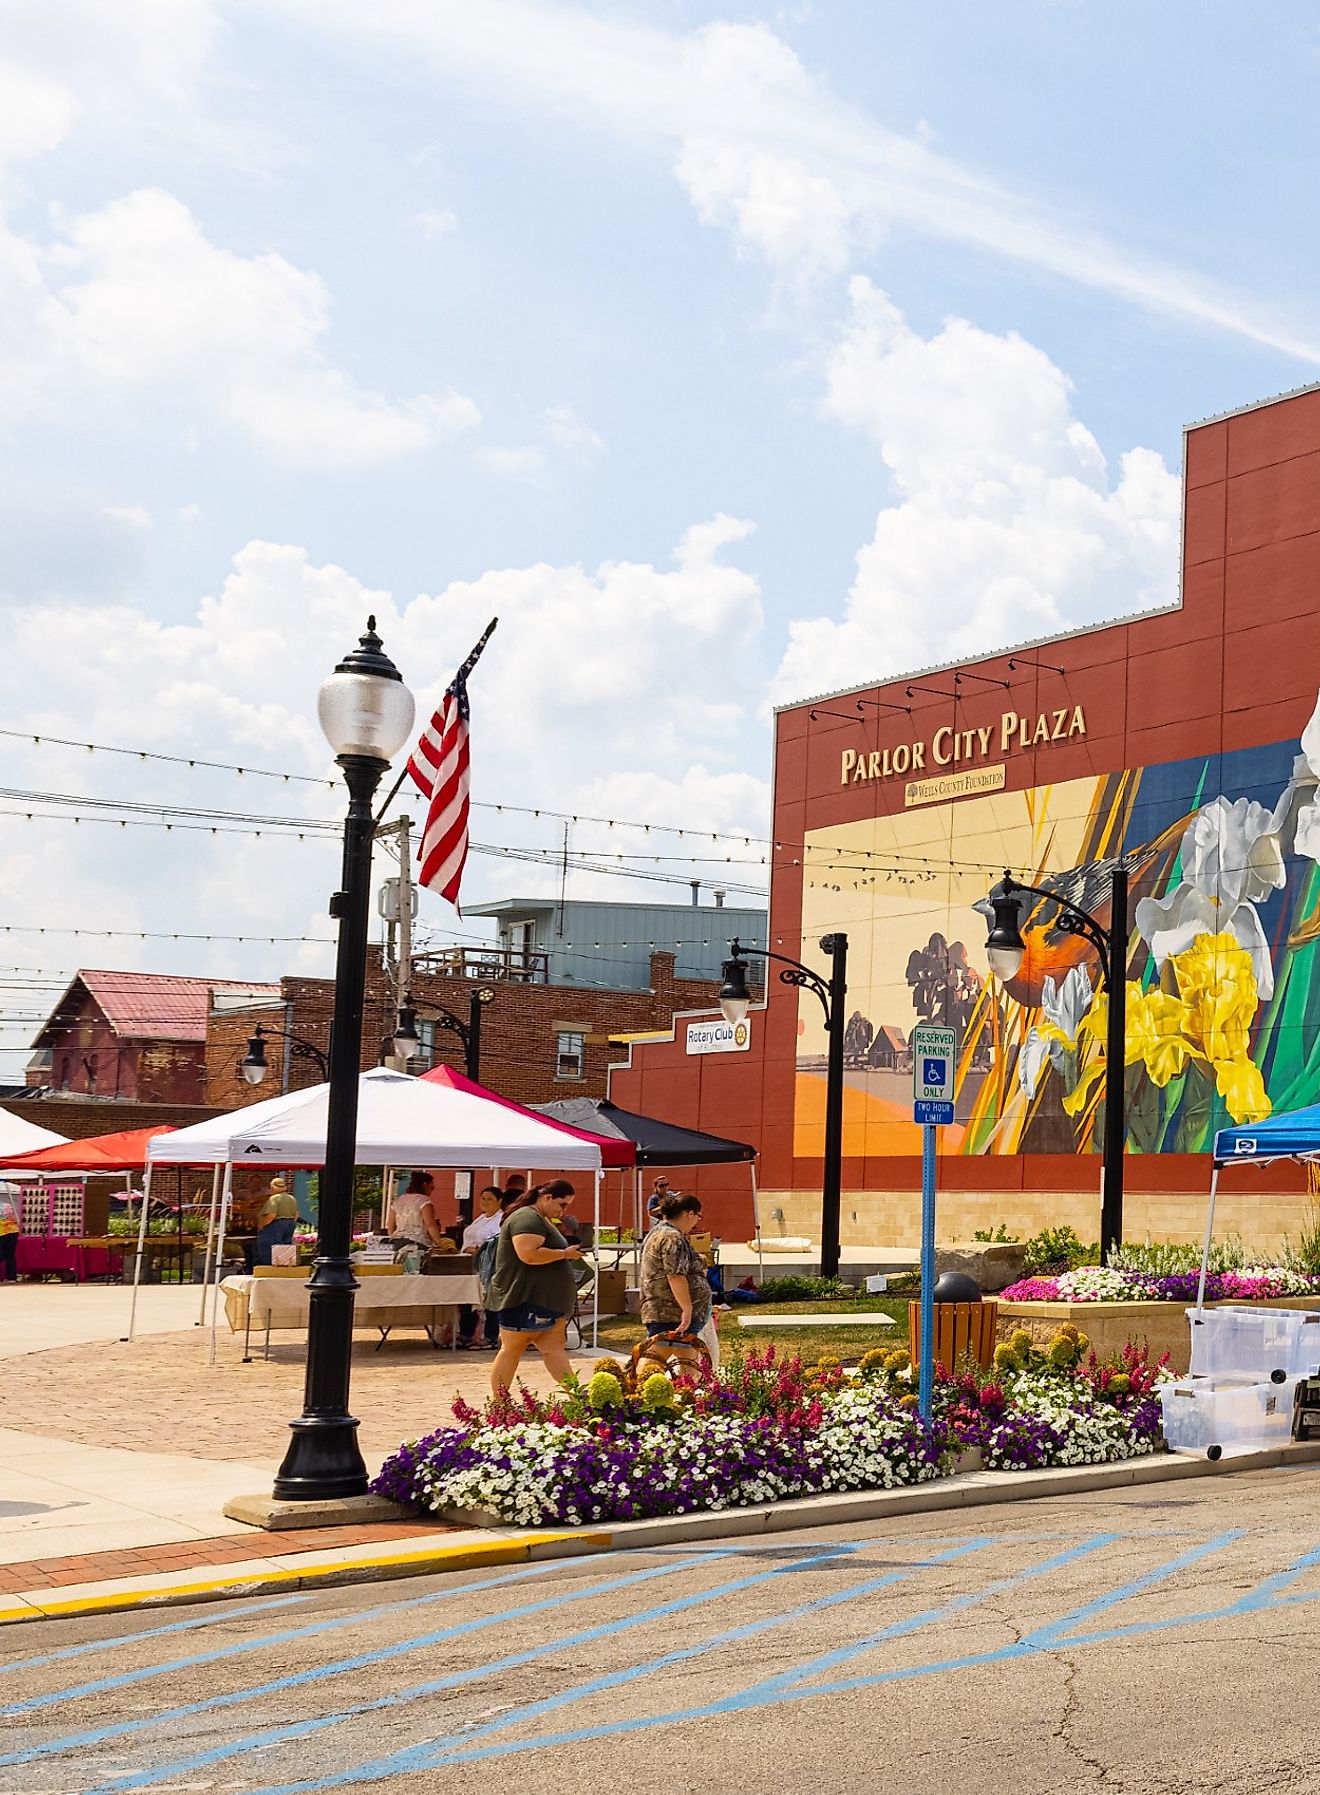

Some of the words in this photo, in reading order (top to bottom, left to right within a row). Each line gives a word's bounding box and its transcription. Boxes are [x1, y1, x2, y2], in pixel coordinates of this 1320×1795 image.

[841, 741, 926, 785] PARLOR
[932, 725, 994, 766] CITY
[1000, 705, 1087, 751] PLAZA
[688, 1030, 714, 1044] Rotary
[714, 1026, 734, 1041] Club
[916, 1031, 954, 1045] RESERVED
[917, 1045, 950, 1057] PARKING
[923, 1086, 945, 1097] ONLY
[918, 1102, 931, 1112] TWO
[932, 1102, 951, 1112] HOUR
[925, 1114, 942, 1122] LIMIT
